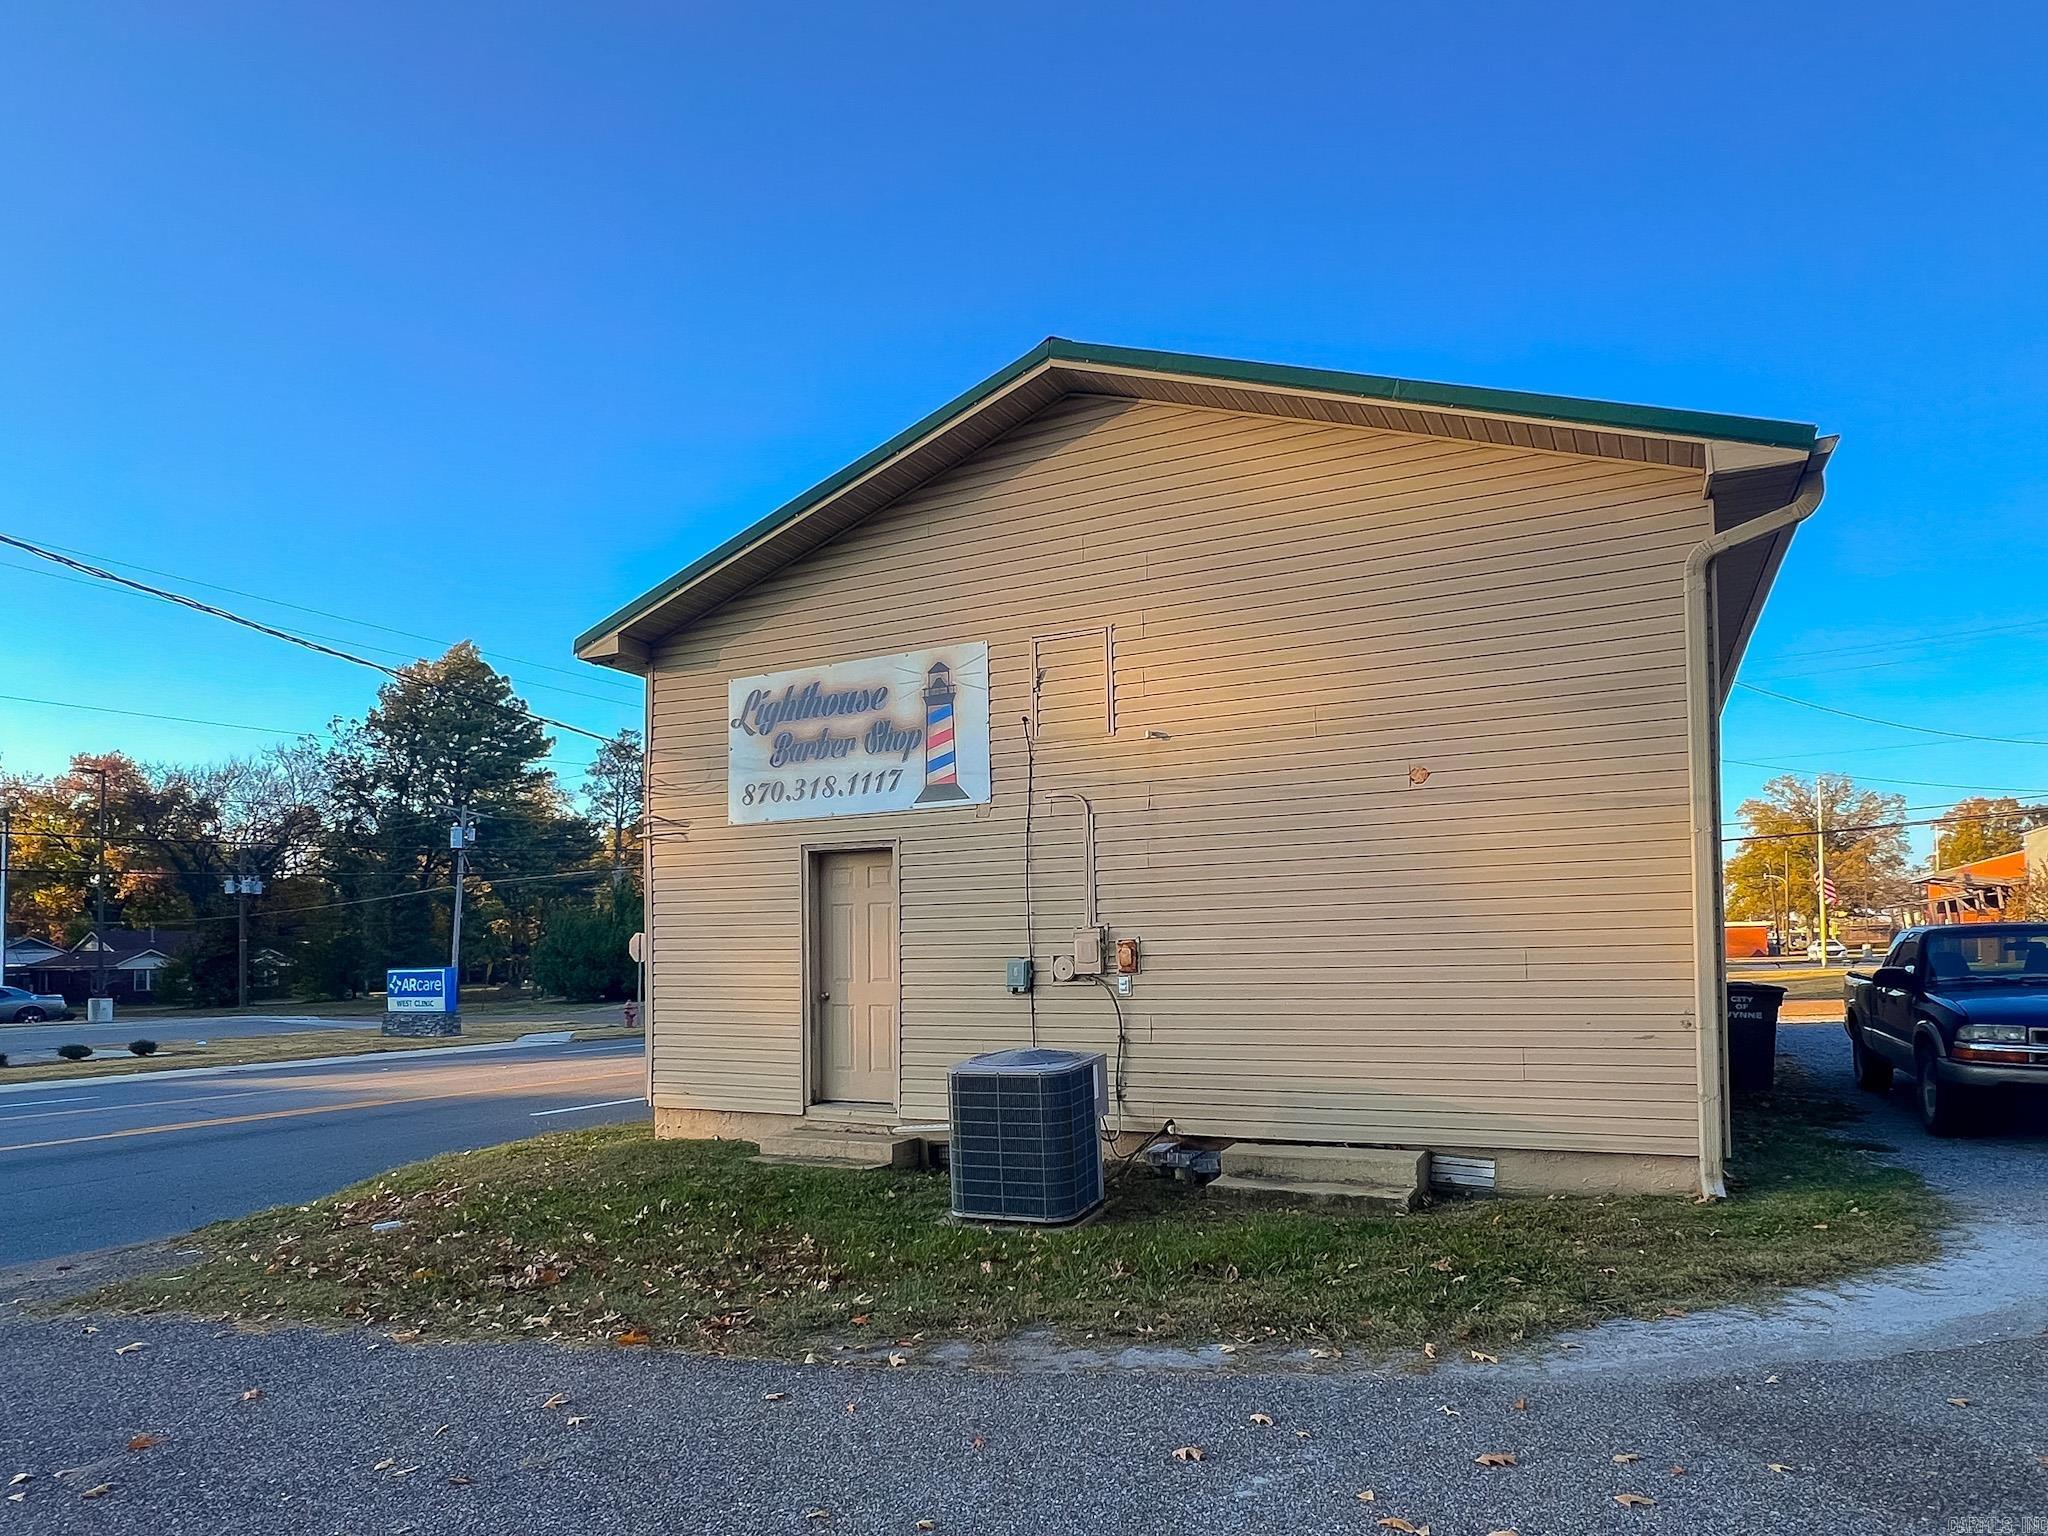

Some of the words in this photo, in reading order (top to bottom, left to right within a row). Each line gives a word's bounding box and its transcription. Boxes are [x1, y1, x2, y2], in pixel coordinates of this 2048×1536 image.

[731, 681, 888, 736] Lighthouse
[770, 728, 857, 768] Barber
[864, 720, 923, 762] Shop
[741, 769, 904, 806] 870.318.1117
[401, 978, 442, 992] ARcare
[397, 1000, 413, 1008] WEST
